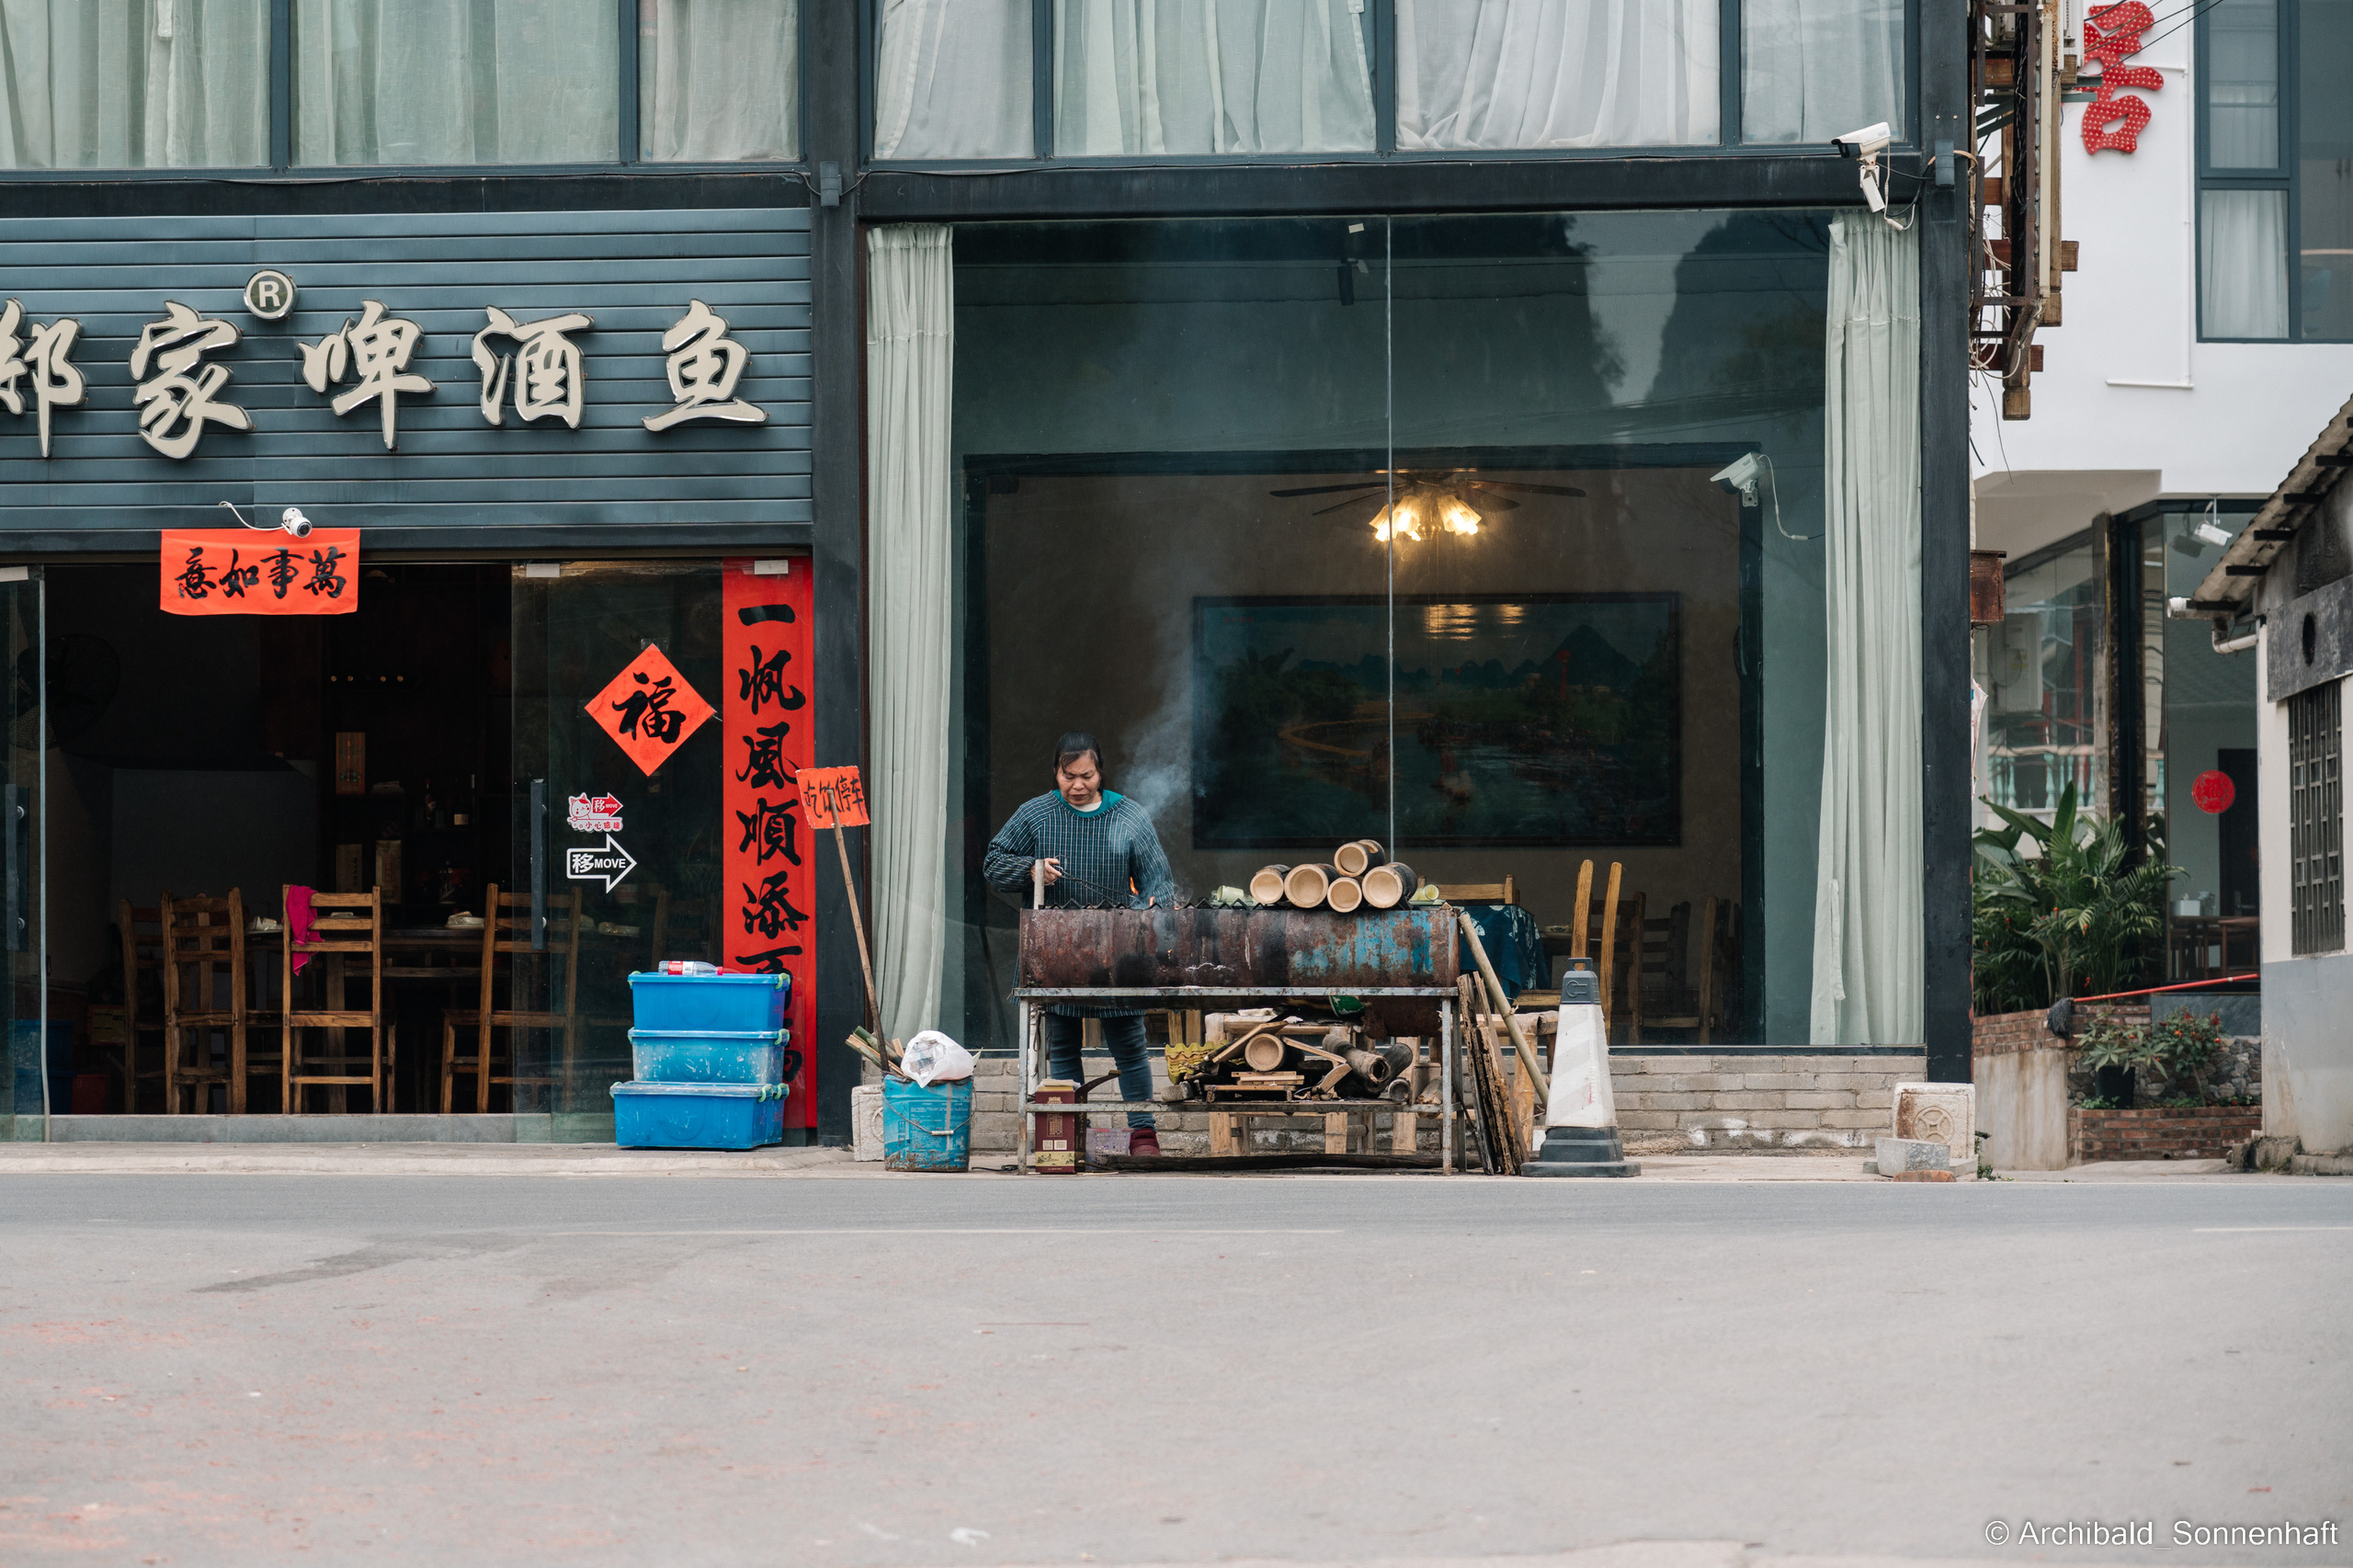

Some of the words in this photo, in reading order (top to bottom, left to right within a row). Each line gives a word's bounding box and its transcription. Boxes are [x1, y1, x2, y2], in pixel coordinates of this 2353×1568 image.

[612, 671, 687, 744] 福
[572, 853, 595, 873] 移
[594, 858, 626, 869] MOVE
